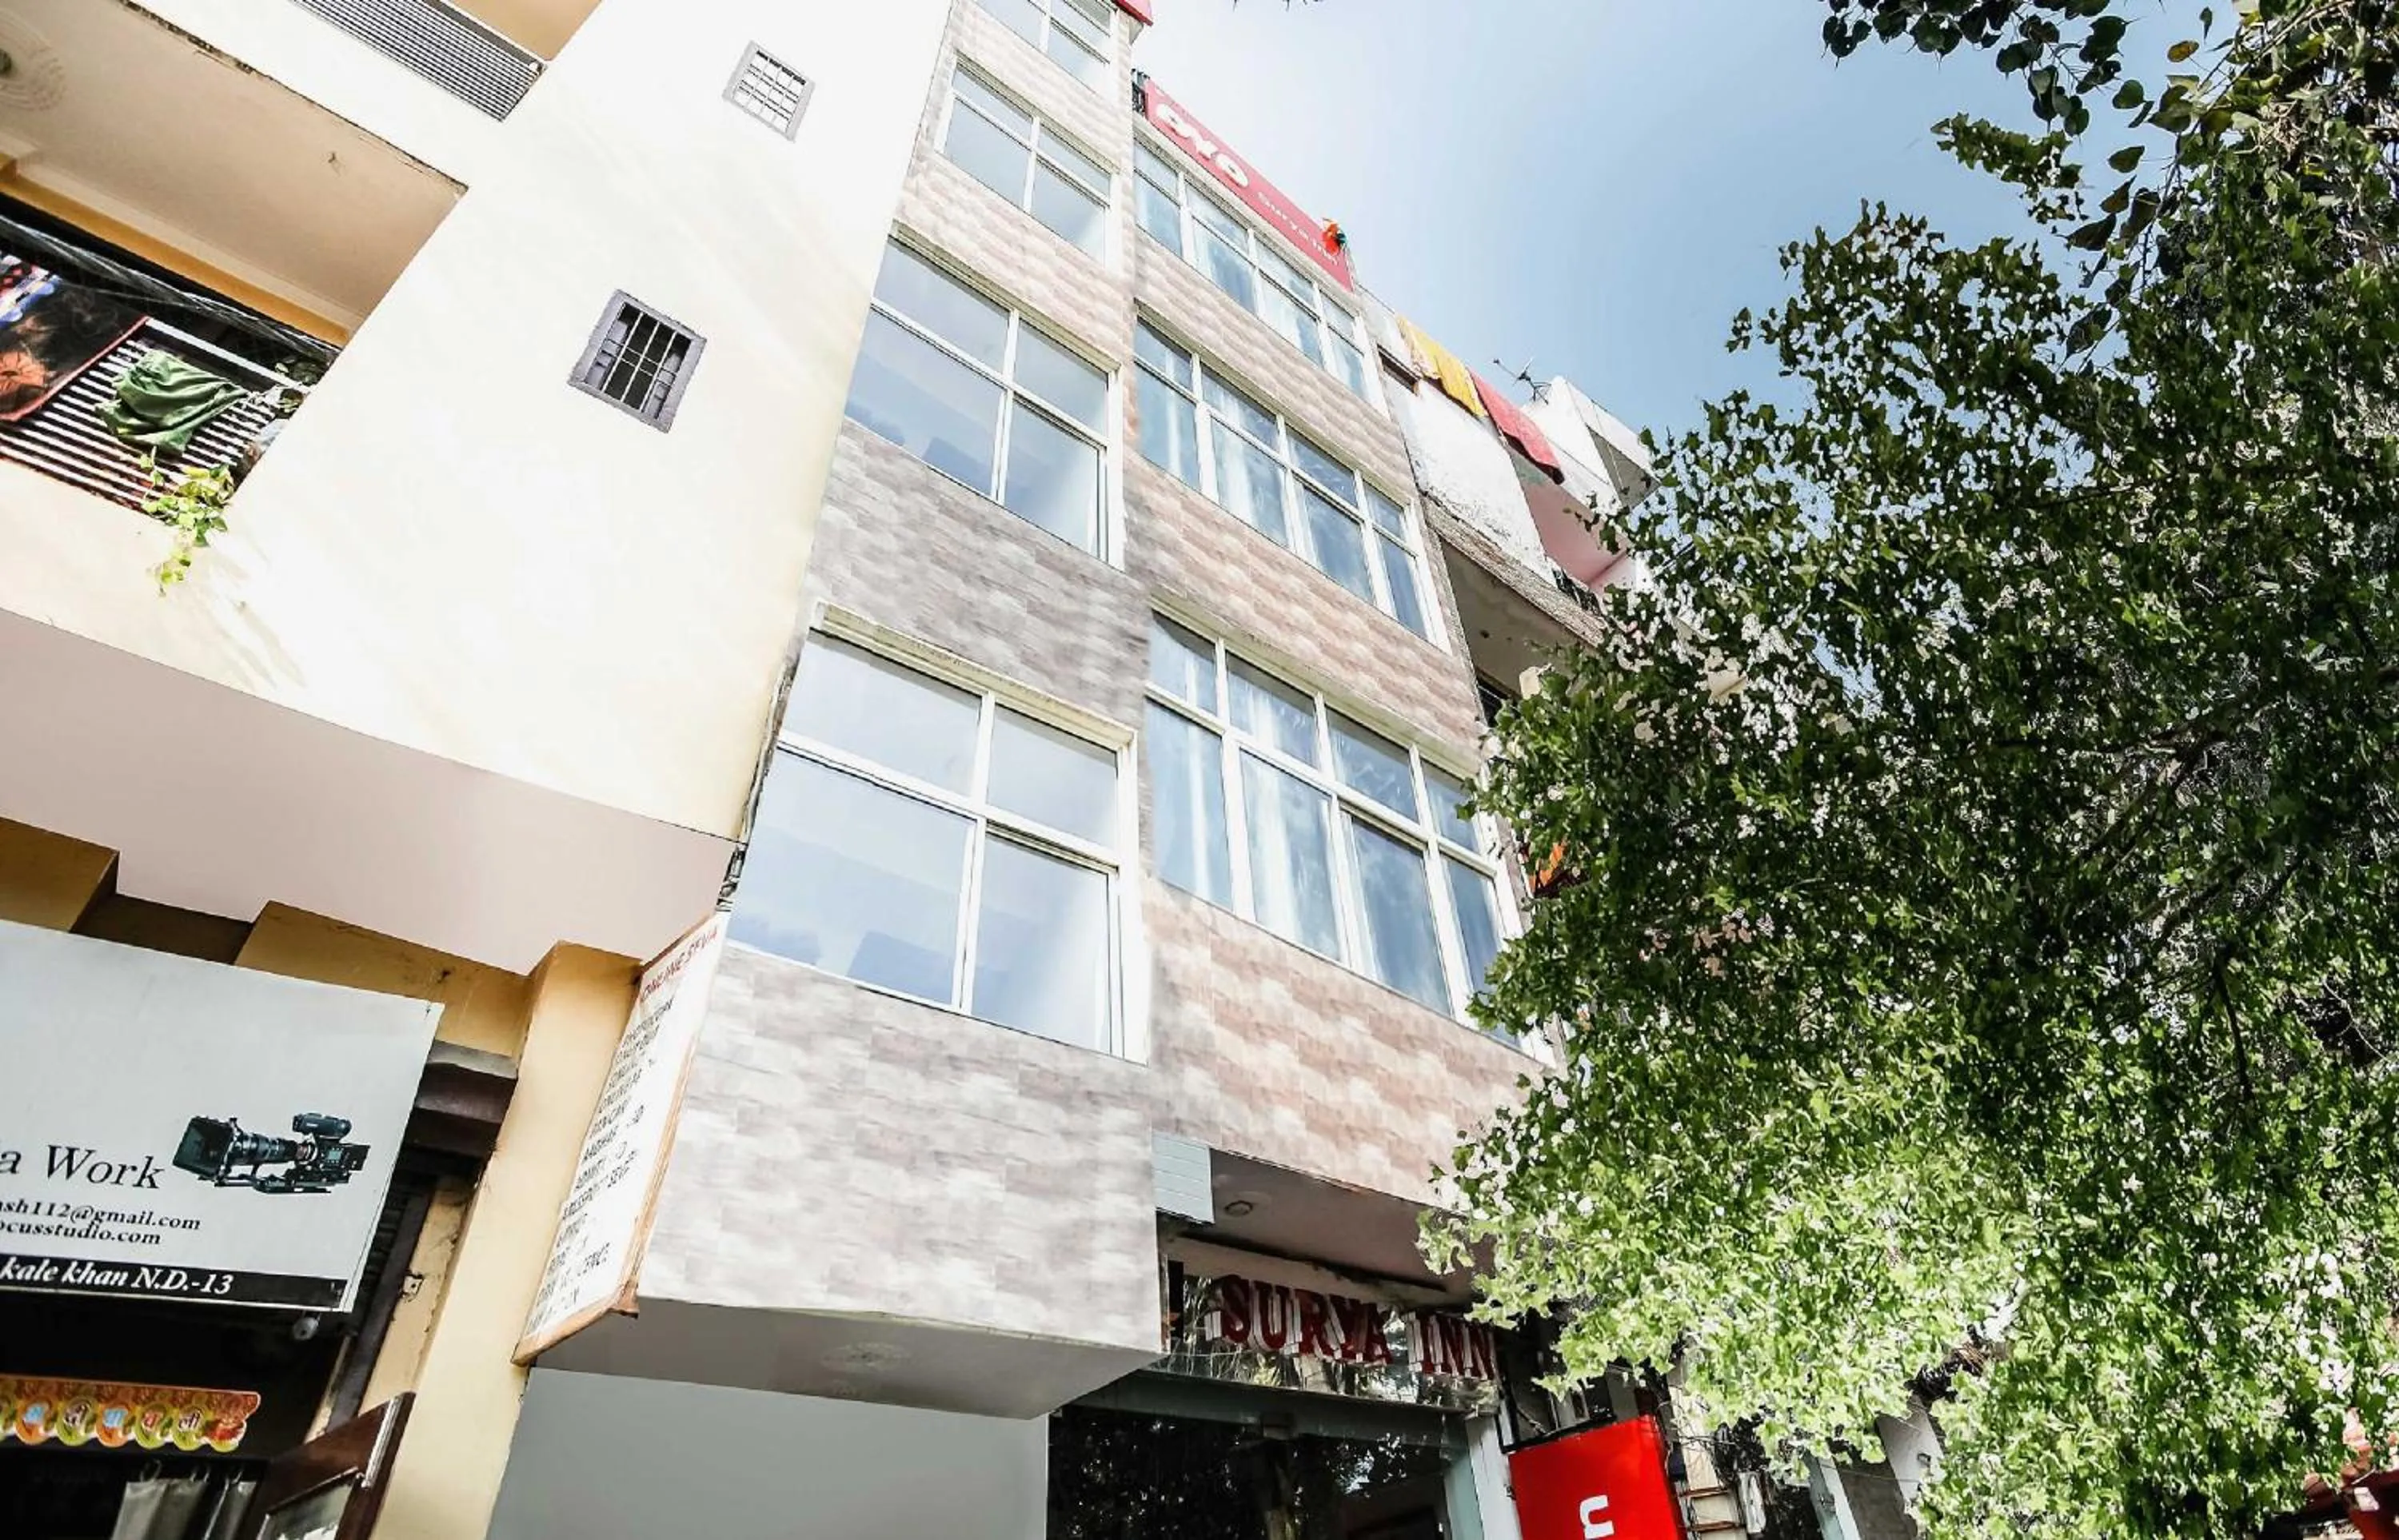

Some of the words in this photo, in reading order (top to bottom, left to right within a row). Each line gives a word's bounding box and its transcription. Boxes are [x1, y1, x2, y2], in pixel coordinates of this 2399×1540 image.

[1157, 102, 1248, 187] OYO
[47, 1144, 165, 1189] Work
[0, 1256, 58, 1282] kale
[62, 1260, 128, 1287] khan
[133, 1267, 234, 1295] N.D.-13
[1205, 1275, 1393, 1366] SURYA
[1403, 1311, 1498, 1382] INN
